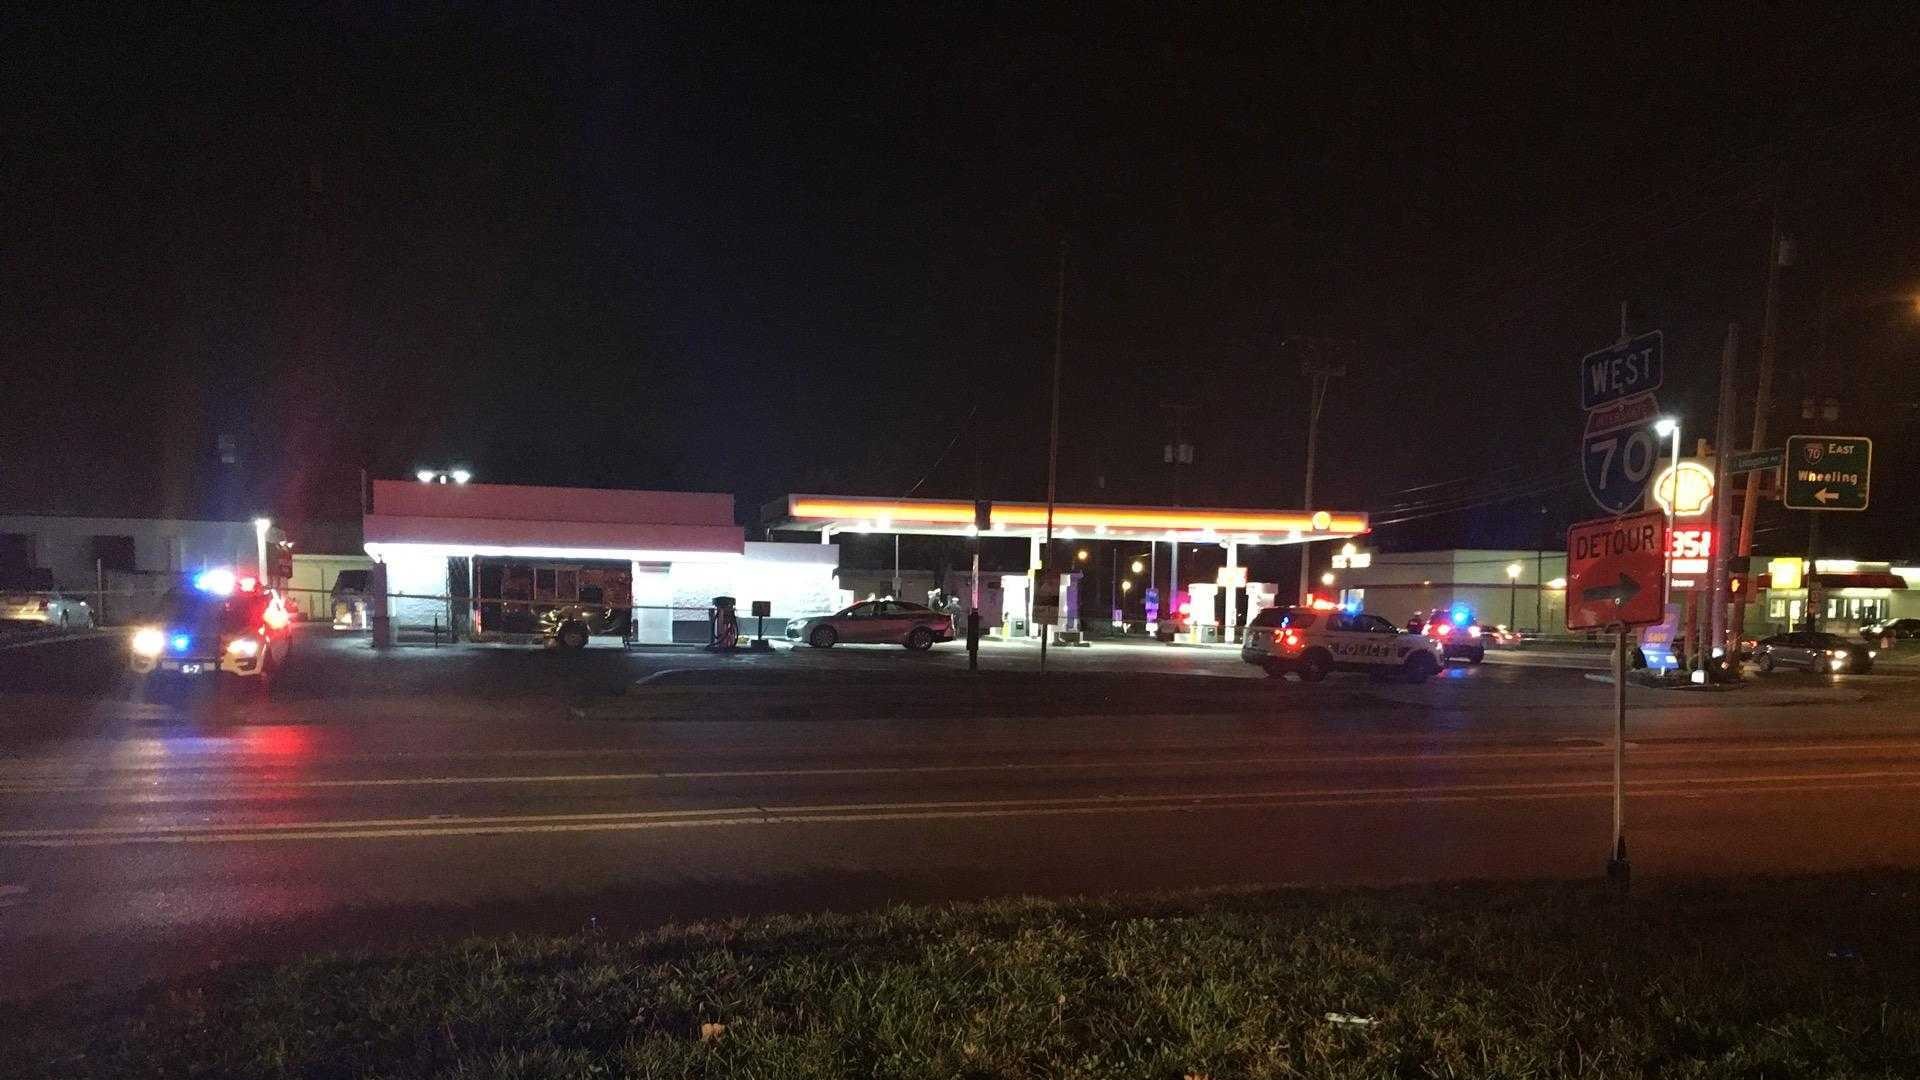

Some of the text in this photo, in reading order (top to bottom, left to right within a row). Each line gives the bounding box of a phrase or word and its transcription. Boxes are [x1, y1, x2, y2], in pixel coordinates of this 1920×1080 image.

[1591, 348, 1654, 395] WEST
[1591, 431, 1652, 489] 70
[1798, 470, 1858, 486] Wheeling
[1576, 524, 1655, 561] DETOUR
